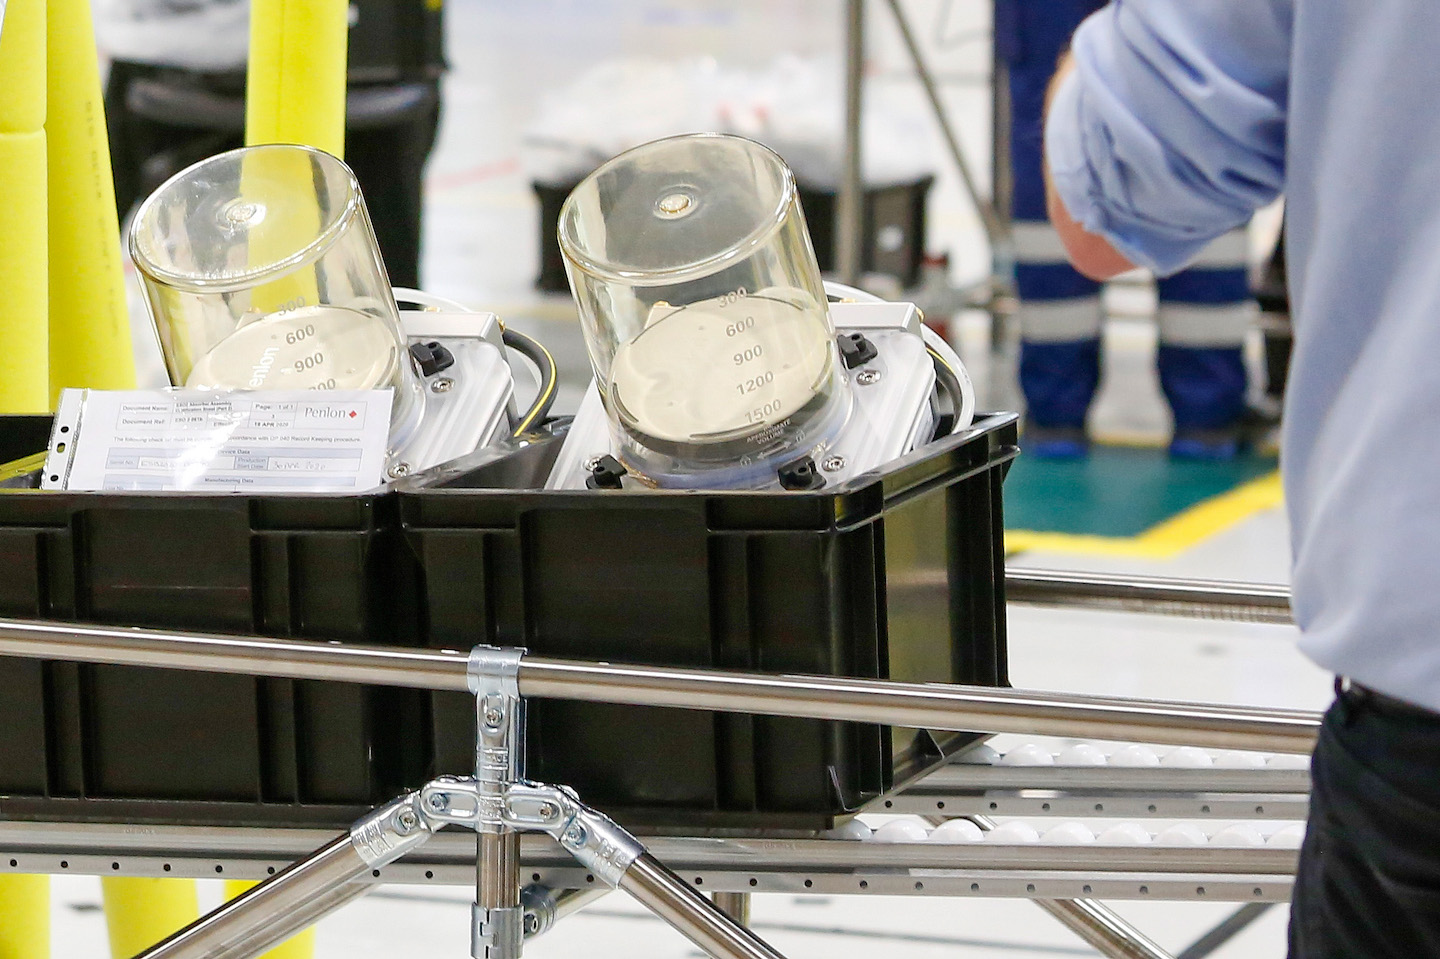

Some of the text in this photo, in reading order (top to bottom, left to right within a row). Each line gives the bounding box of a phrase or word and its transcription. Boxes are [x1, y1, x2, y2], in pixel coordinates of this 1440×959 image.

[278, 296, 306, 316] 300
[717, 286, 748, 309] 300
[285, 324, 315, 345] 600
[725, 316, 755, 337] 600
[294, 352, 324, 373] 900
[733, 344, 763, 366] 900
[736, 371, 774, 396] 1200
[304, 407, 346, 419] Penlon
[744, 399, 782, 424] 1500
